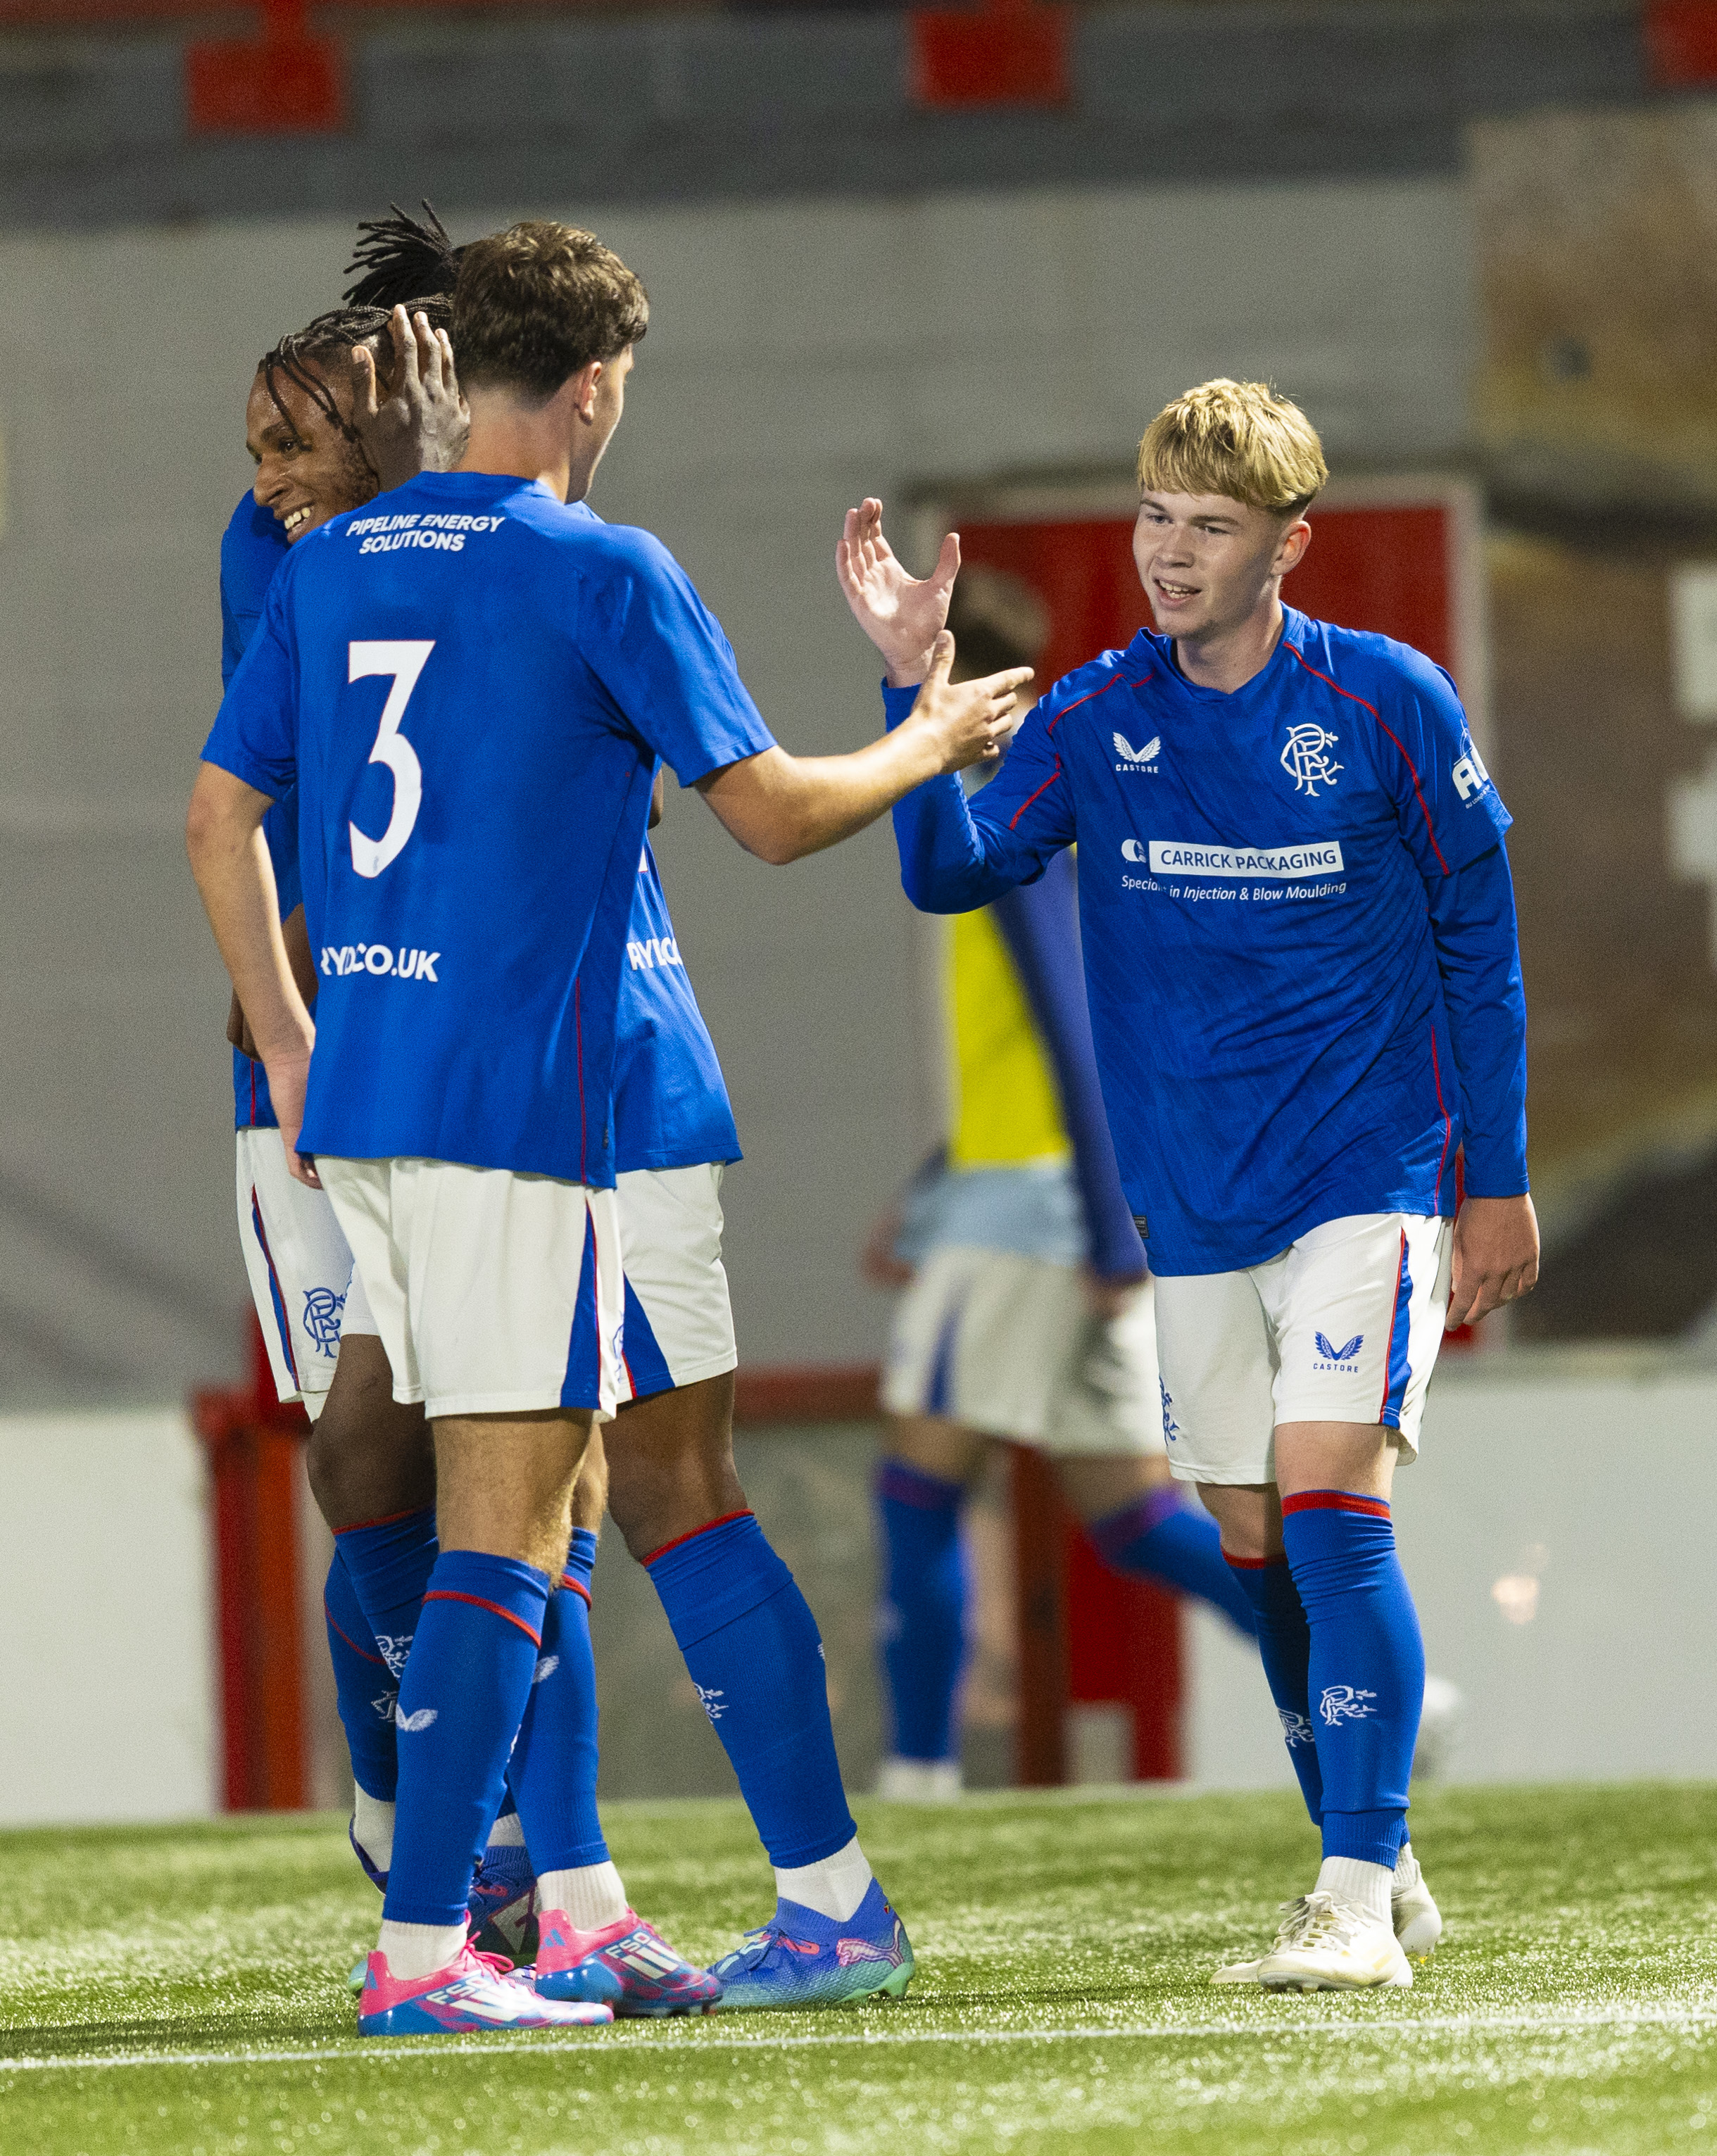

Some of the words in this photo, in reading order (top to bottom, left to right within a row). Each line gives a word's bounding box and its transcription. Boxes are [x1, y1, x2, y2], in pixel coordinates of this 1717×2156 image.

[346, 514, 422, 537] PIPELINE
[420, 514, 505, 533] ENERGY
[359, 529, 466, 555] SOLUTIONS
[348, 639, 436, 879] 3
[1115, 764, 1159, 774] CASTORE
[1160, 849, 1233, 869] CARRICK
[1235, 849, 1337, 871] PACKAGING
[1169, 885, 1181, 898] in
[1183, 885, 1236, 902] Injection
[1239, 887, 1250, 900] &
[1252, 887, 1283, 900] Blow
[1285, 882, 1347, 899] Moulding
[1313, 1363, 1359, 1373] CASTORE
